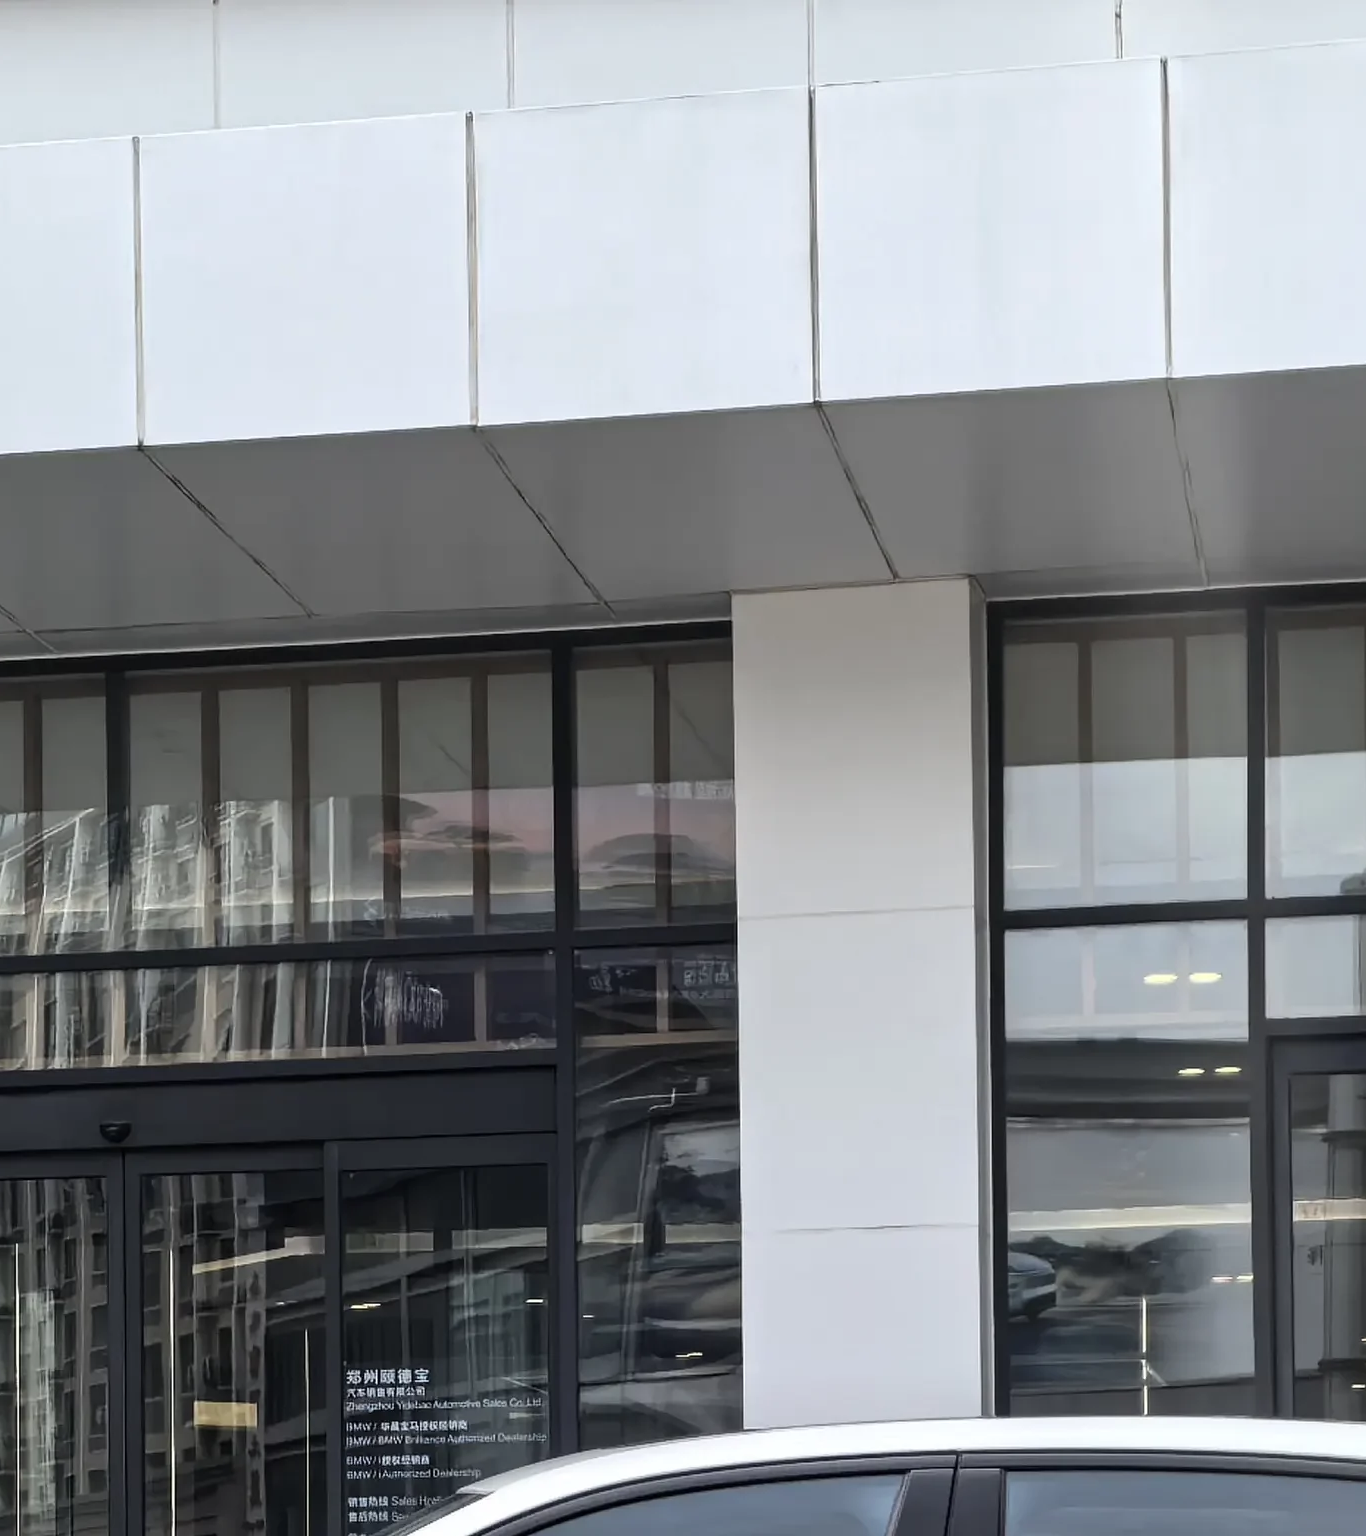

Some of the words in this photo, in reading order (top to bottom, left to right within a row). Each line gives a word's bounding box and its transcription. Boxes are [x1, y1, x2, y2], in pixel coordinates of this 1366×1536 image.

[346, 1401, 395, 1413] Zhengzhou
[483, 1399, 508, 1408] Sales
[391, 1496, 417, 1507] Sales
